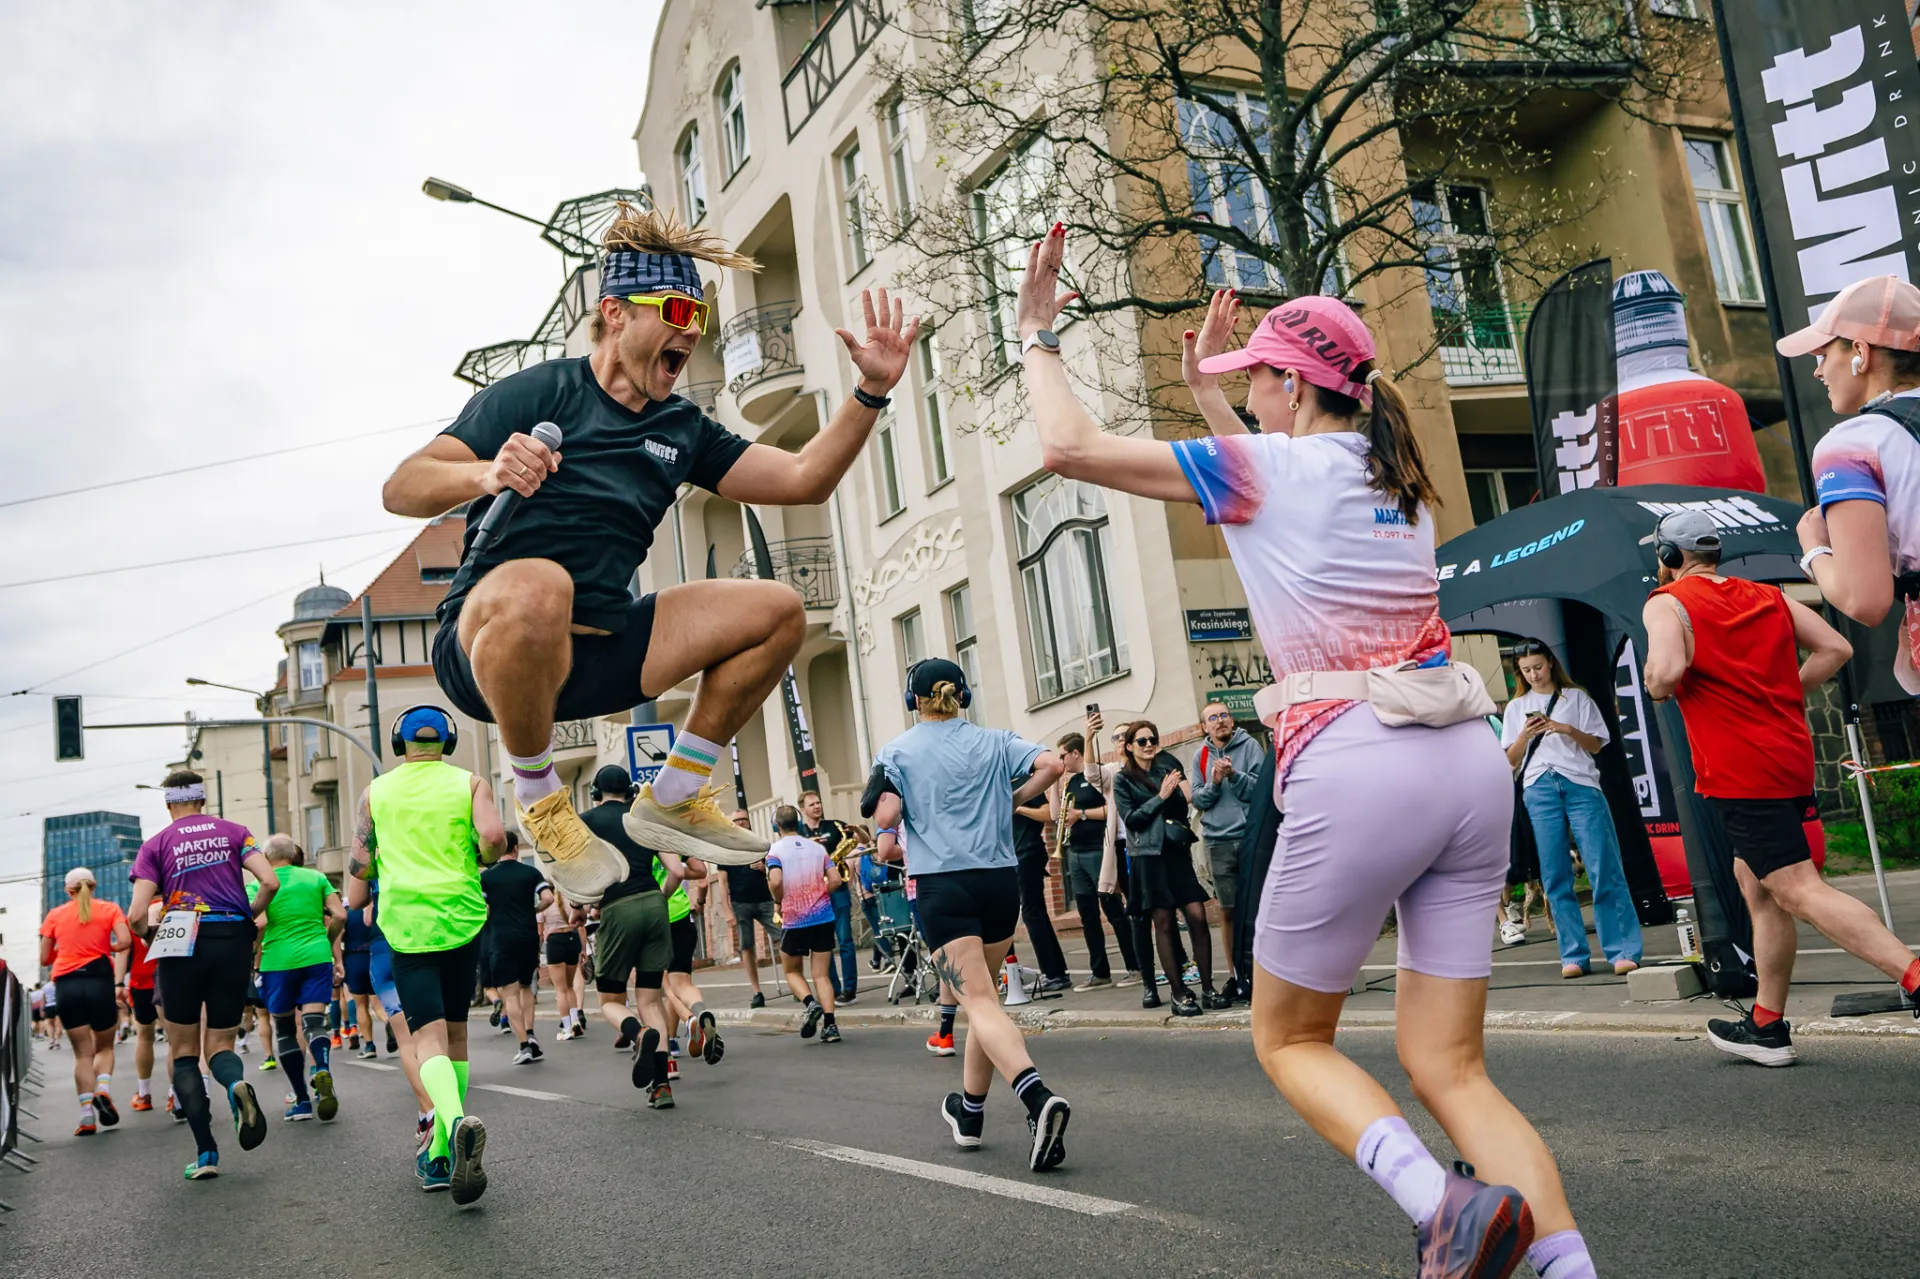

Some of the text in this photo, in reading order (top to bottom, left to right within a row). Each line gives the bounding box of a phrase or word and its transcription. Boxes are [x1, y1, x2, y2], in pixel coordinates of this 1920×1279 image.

[1873, 14, 1908, 128] DRINK
[1298, 326, 1355, 377] RUN
[1602, 401, 1614, 461] DRINK
[1462, 559, 1481, 576] A
[1489, 519, 1586, 568] LEGEND
[1190, 618, 1249, 631] Krasińskiego
[172, 836, 230, 856] WARTKIE
[177, 822, 217, 835] TOMEK
[175, 850, 231, 871] PIERONY
